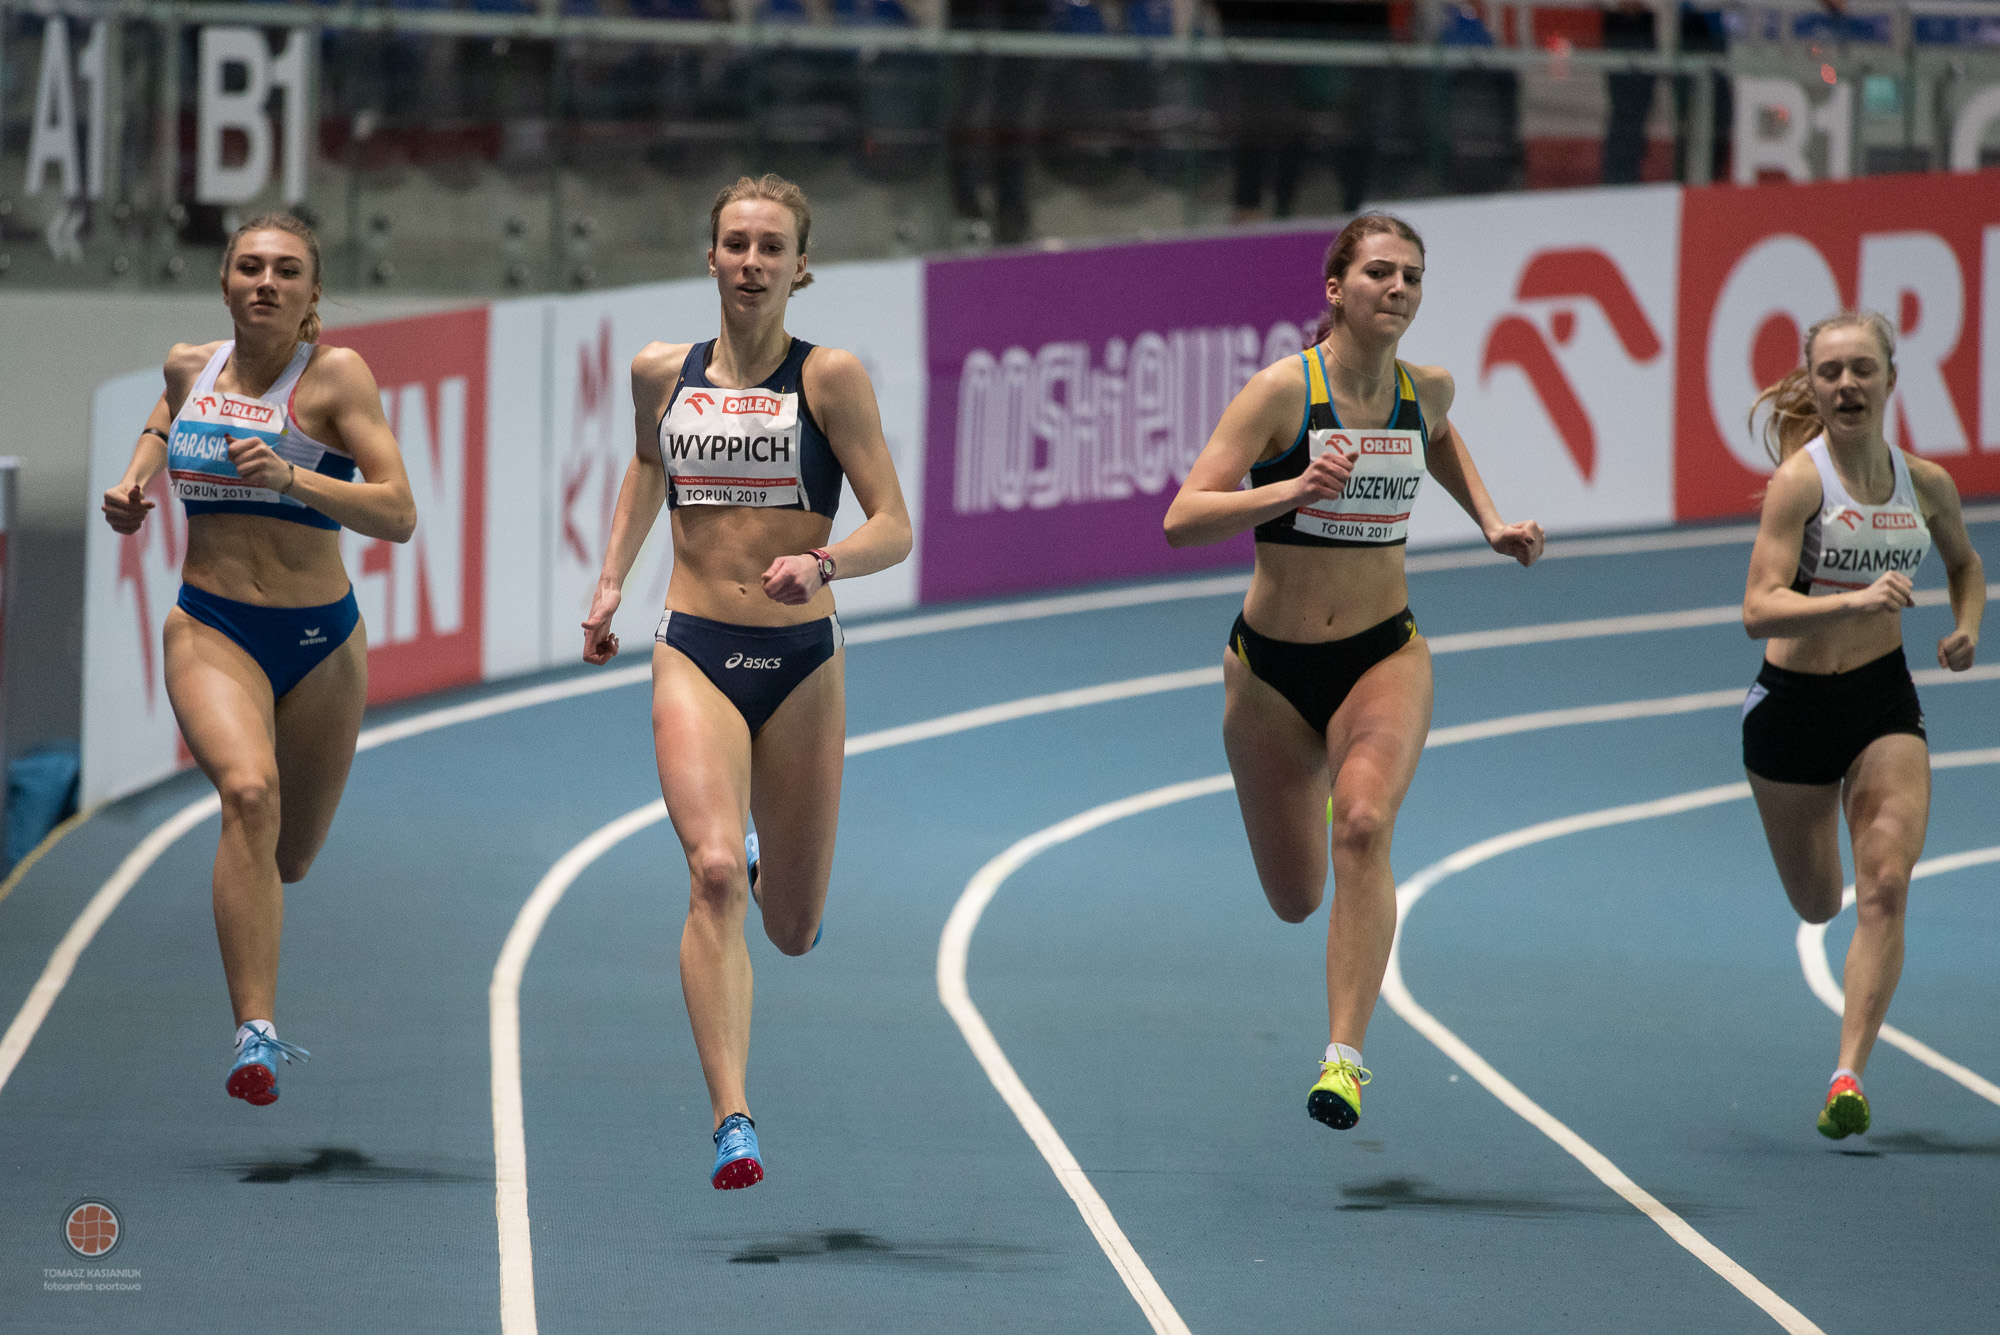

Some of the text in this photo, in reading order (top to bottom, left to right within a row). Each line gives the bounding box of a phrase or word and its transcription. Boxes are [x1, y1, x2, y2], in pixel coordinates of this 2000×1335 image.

[25, 17, 104, 197] A1
[196, 26, 308, 204] B1
[1706, 224, 2000, 478] OR
[222, 403, 270, 421] ORLEN
[725, 398, 777, 414] ORLEN
[171, 432, 227, 461] FARASIE
[669, 434, 790, 462] WYPPICH
[1363, 439, 1410, 454] ORLEN
[179, 482, 252, 499] TORUŃ 2019
[686, 487, 767, 503] TORUŃ 2019
[1339, 476, 1420, 501] USZEWICZ
[1321, 523, 1364, 538] TORUŃ
[1823, 548, 1922, 572] DZIAMSKA
[743, 657, 782, 670] asics
